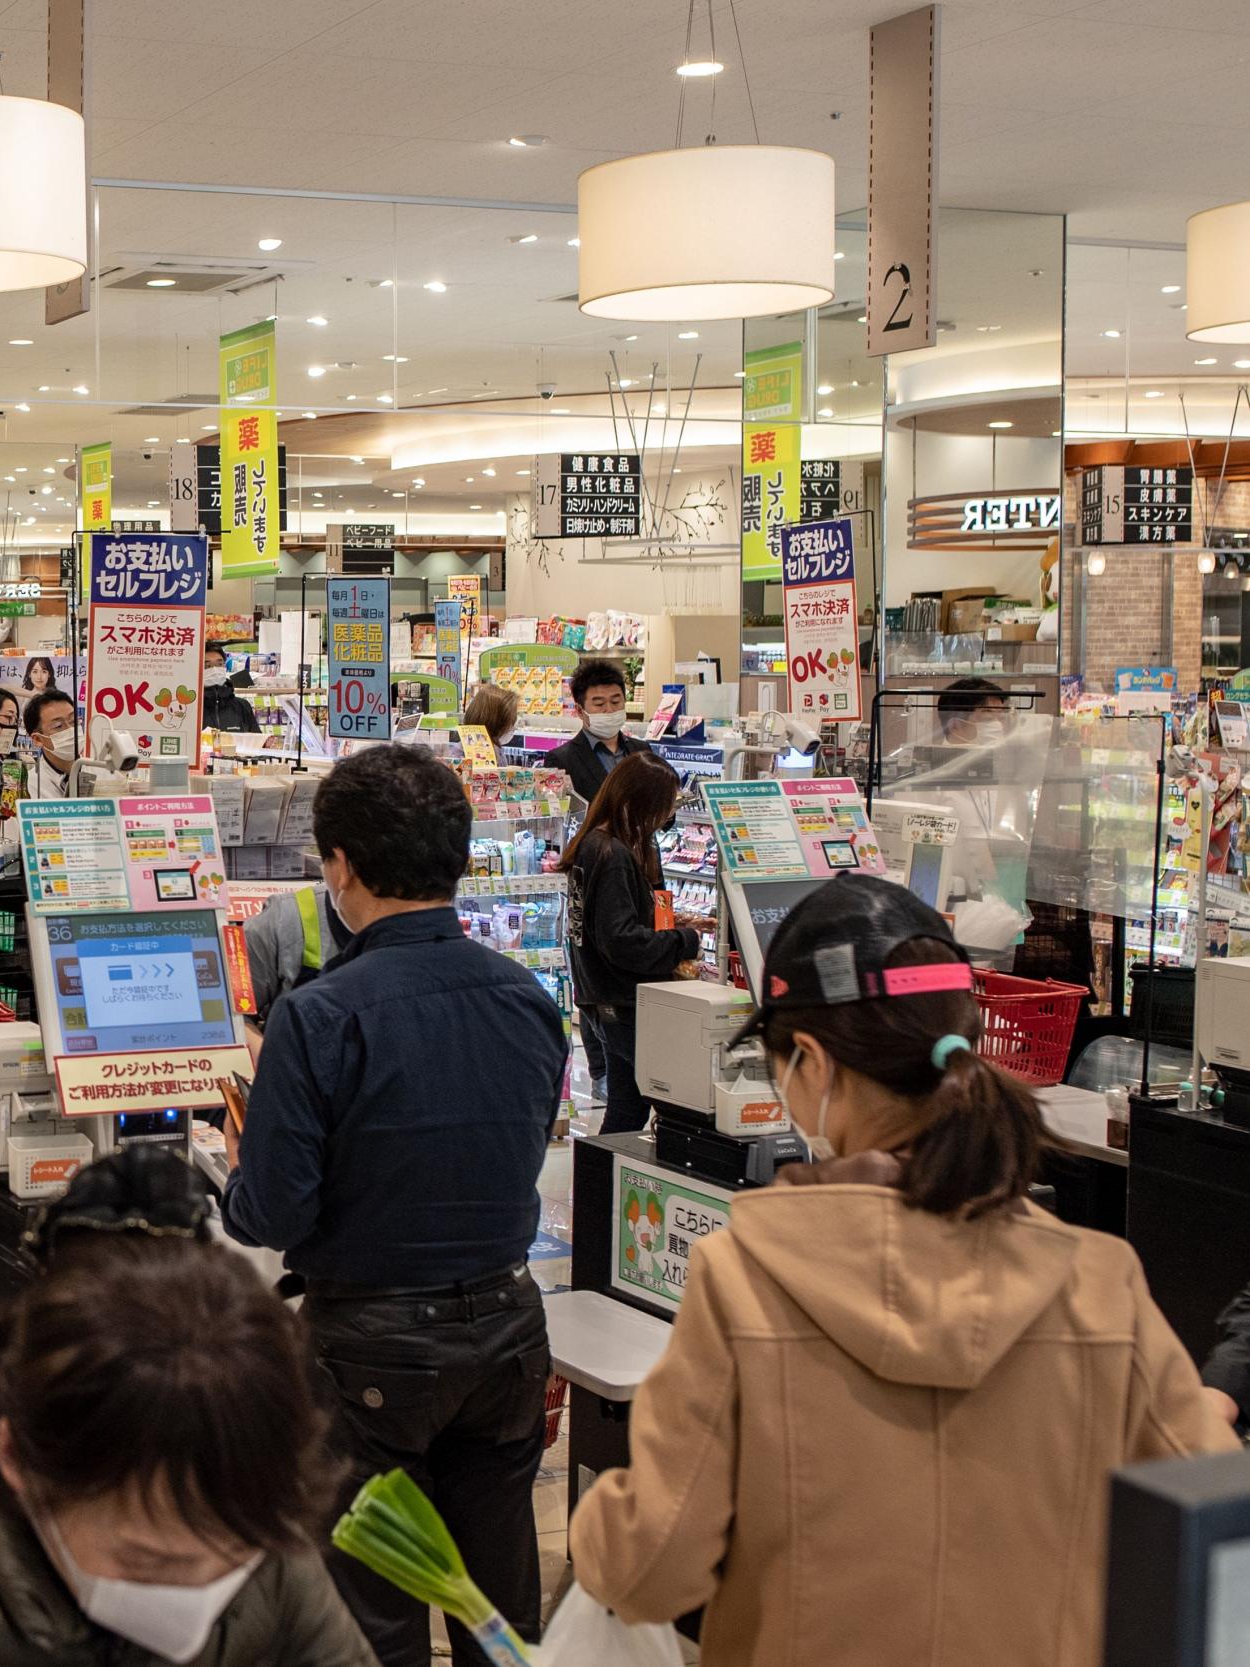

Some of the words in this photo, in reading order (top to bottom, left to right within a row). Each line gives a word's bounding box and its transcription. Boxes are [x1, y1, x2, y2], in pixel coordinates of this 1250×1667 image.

[882, 263, 913, 332] 2
[572, 457, 630, 473] 健康食品
[173, 478, 193, 500] 18
[566, 476, 635, 493] 男性化粧品
[541, 485, 557, 505] 17
[1140, 488, 1177, 503] 皮膚薬
[566, 498, 635, 513] カミソリ・ハンドクリーム
[1106, 496, 1120, 514] 15
[1129, 507, 1187, 521] スキンケア
[566, 518, 635, 534] 日焼け止め・制汗剤
[1140, 525, 1176, 540] 漢方薬
[789, 529, 844, 556] お支払い
[105, 542, 194, 572] お支払い
[785, 550, 850, 580] セルフレジ
[96, 571, 201, 600] セルフレジ
[798, 589, 836, 600] こちらのレジで
[332, 602, 384, 619] 毎週土曜日は
[790, 598, 850, 619] スマホ決済
[117, 614, 178, 623] こちらのレジで
[795, 617, 844, 628] がご利用になれます
[100, 626, 195, 646] スマホ決済
[333, 623, 383, 642] 医薬品
[107, 646, 186, 656] がご利用になれます
[333, 643, 383, 662] 化粧品
[791, 648, 827, 683] OK
[95, 681, 154, 719] OK
[331, 680, 387, 715] 10%
[340, 715, 378, 732] OFF
[101, 1058, 212, 1079] クレジットカードの
[67, 1075, 250, 1101] ご利用方法が変更になりまし
